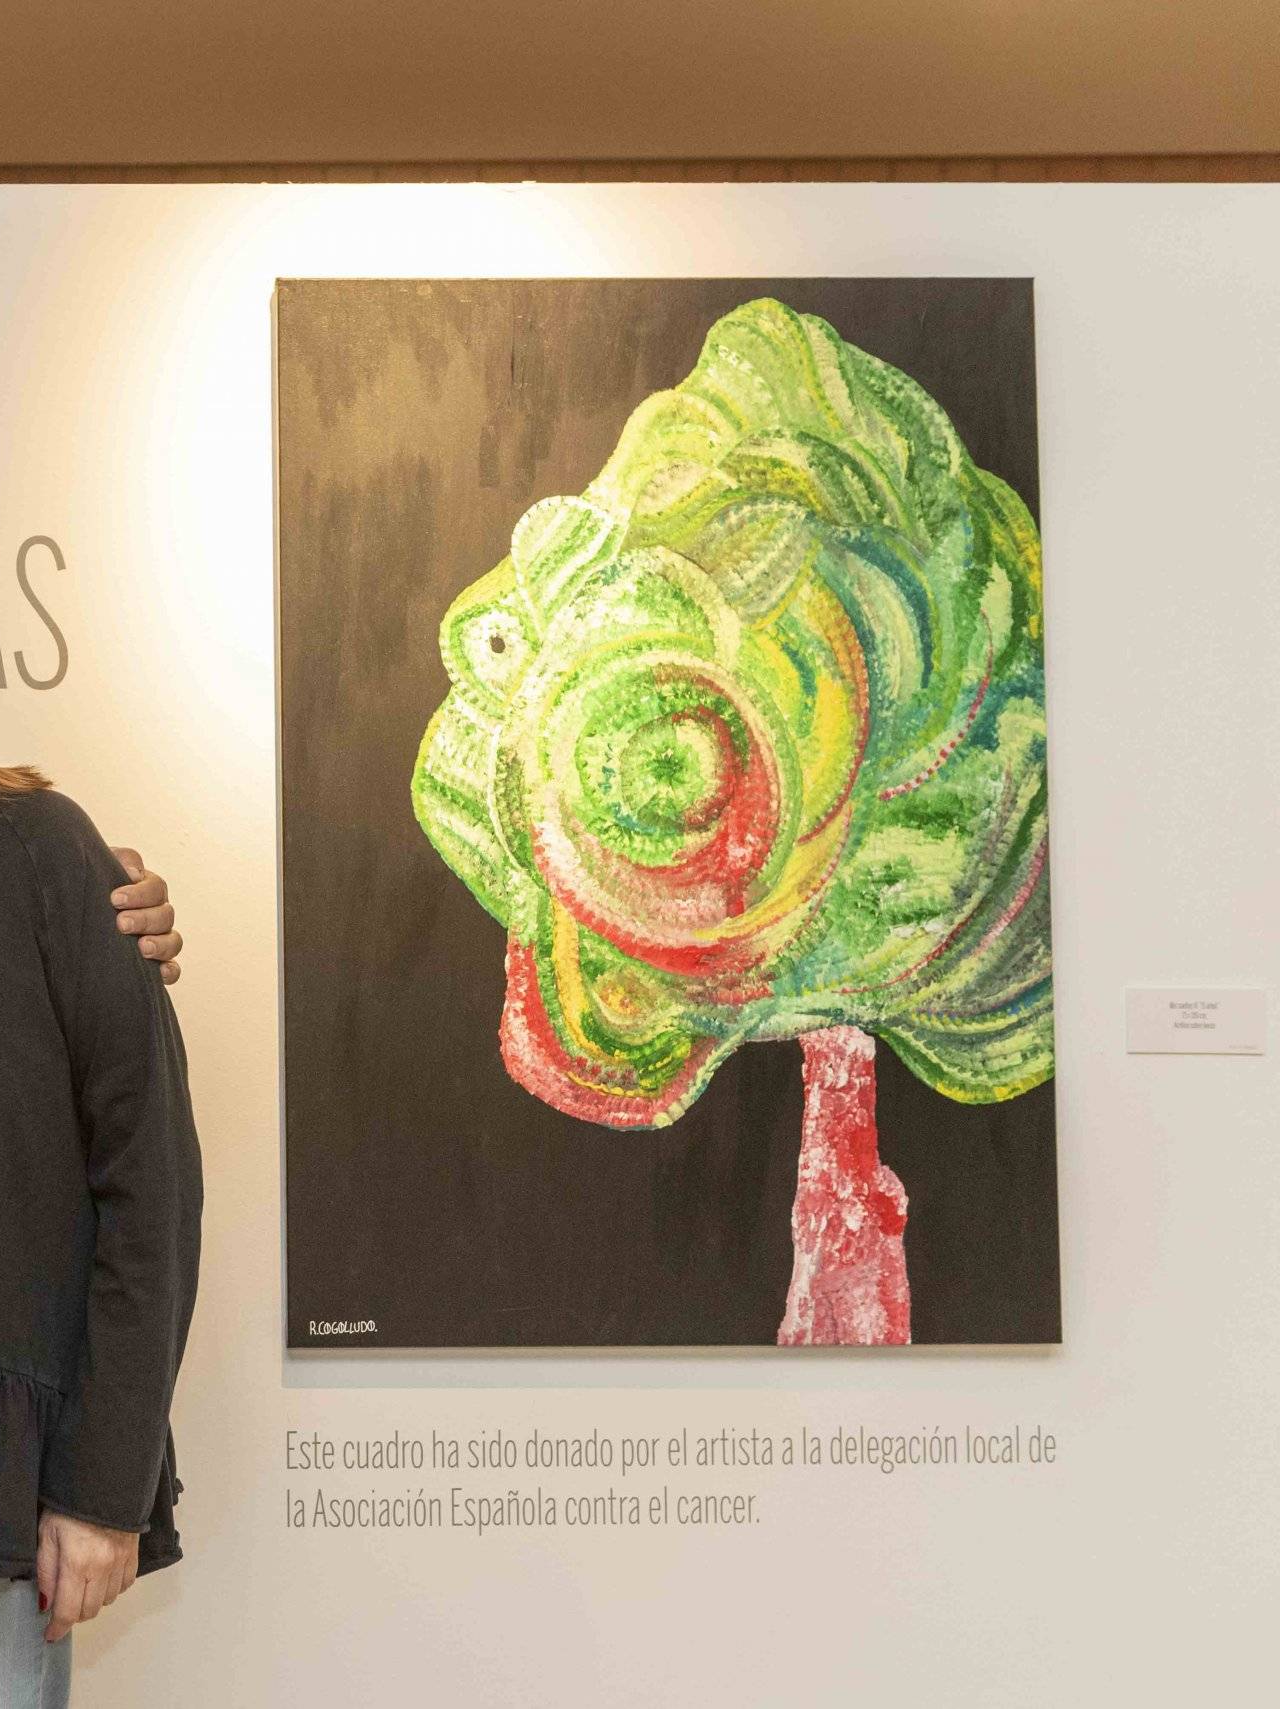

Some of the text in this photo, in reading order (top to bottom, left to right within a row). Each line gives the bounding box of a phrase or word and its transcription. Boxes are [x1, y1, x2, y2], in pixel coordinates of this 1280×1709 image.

[286, 1424, 1057, 1476] Este cuadro ha sido donado por el artista a la delegación local de
[286, 1486, 761, 1536] la Asociación Española contra el cancer.
